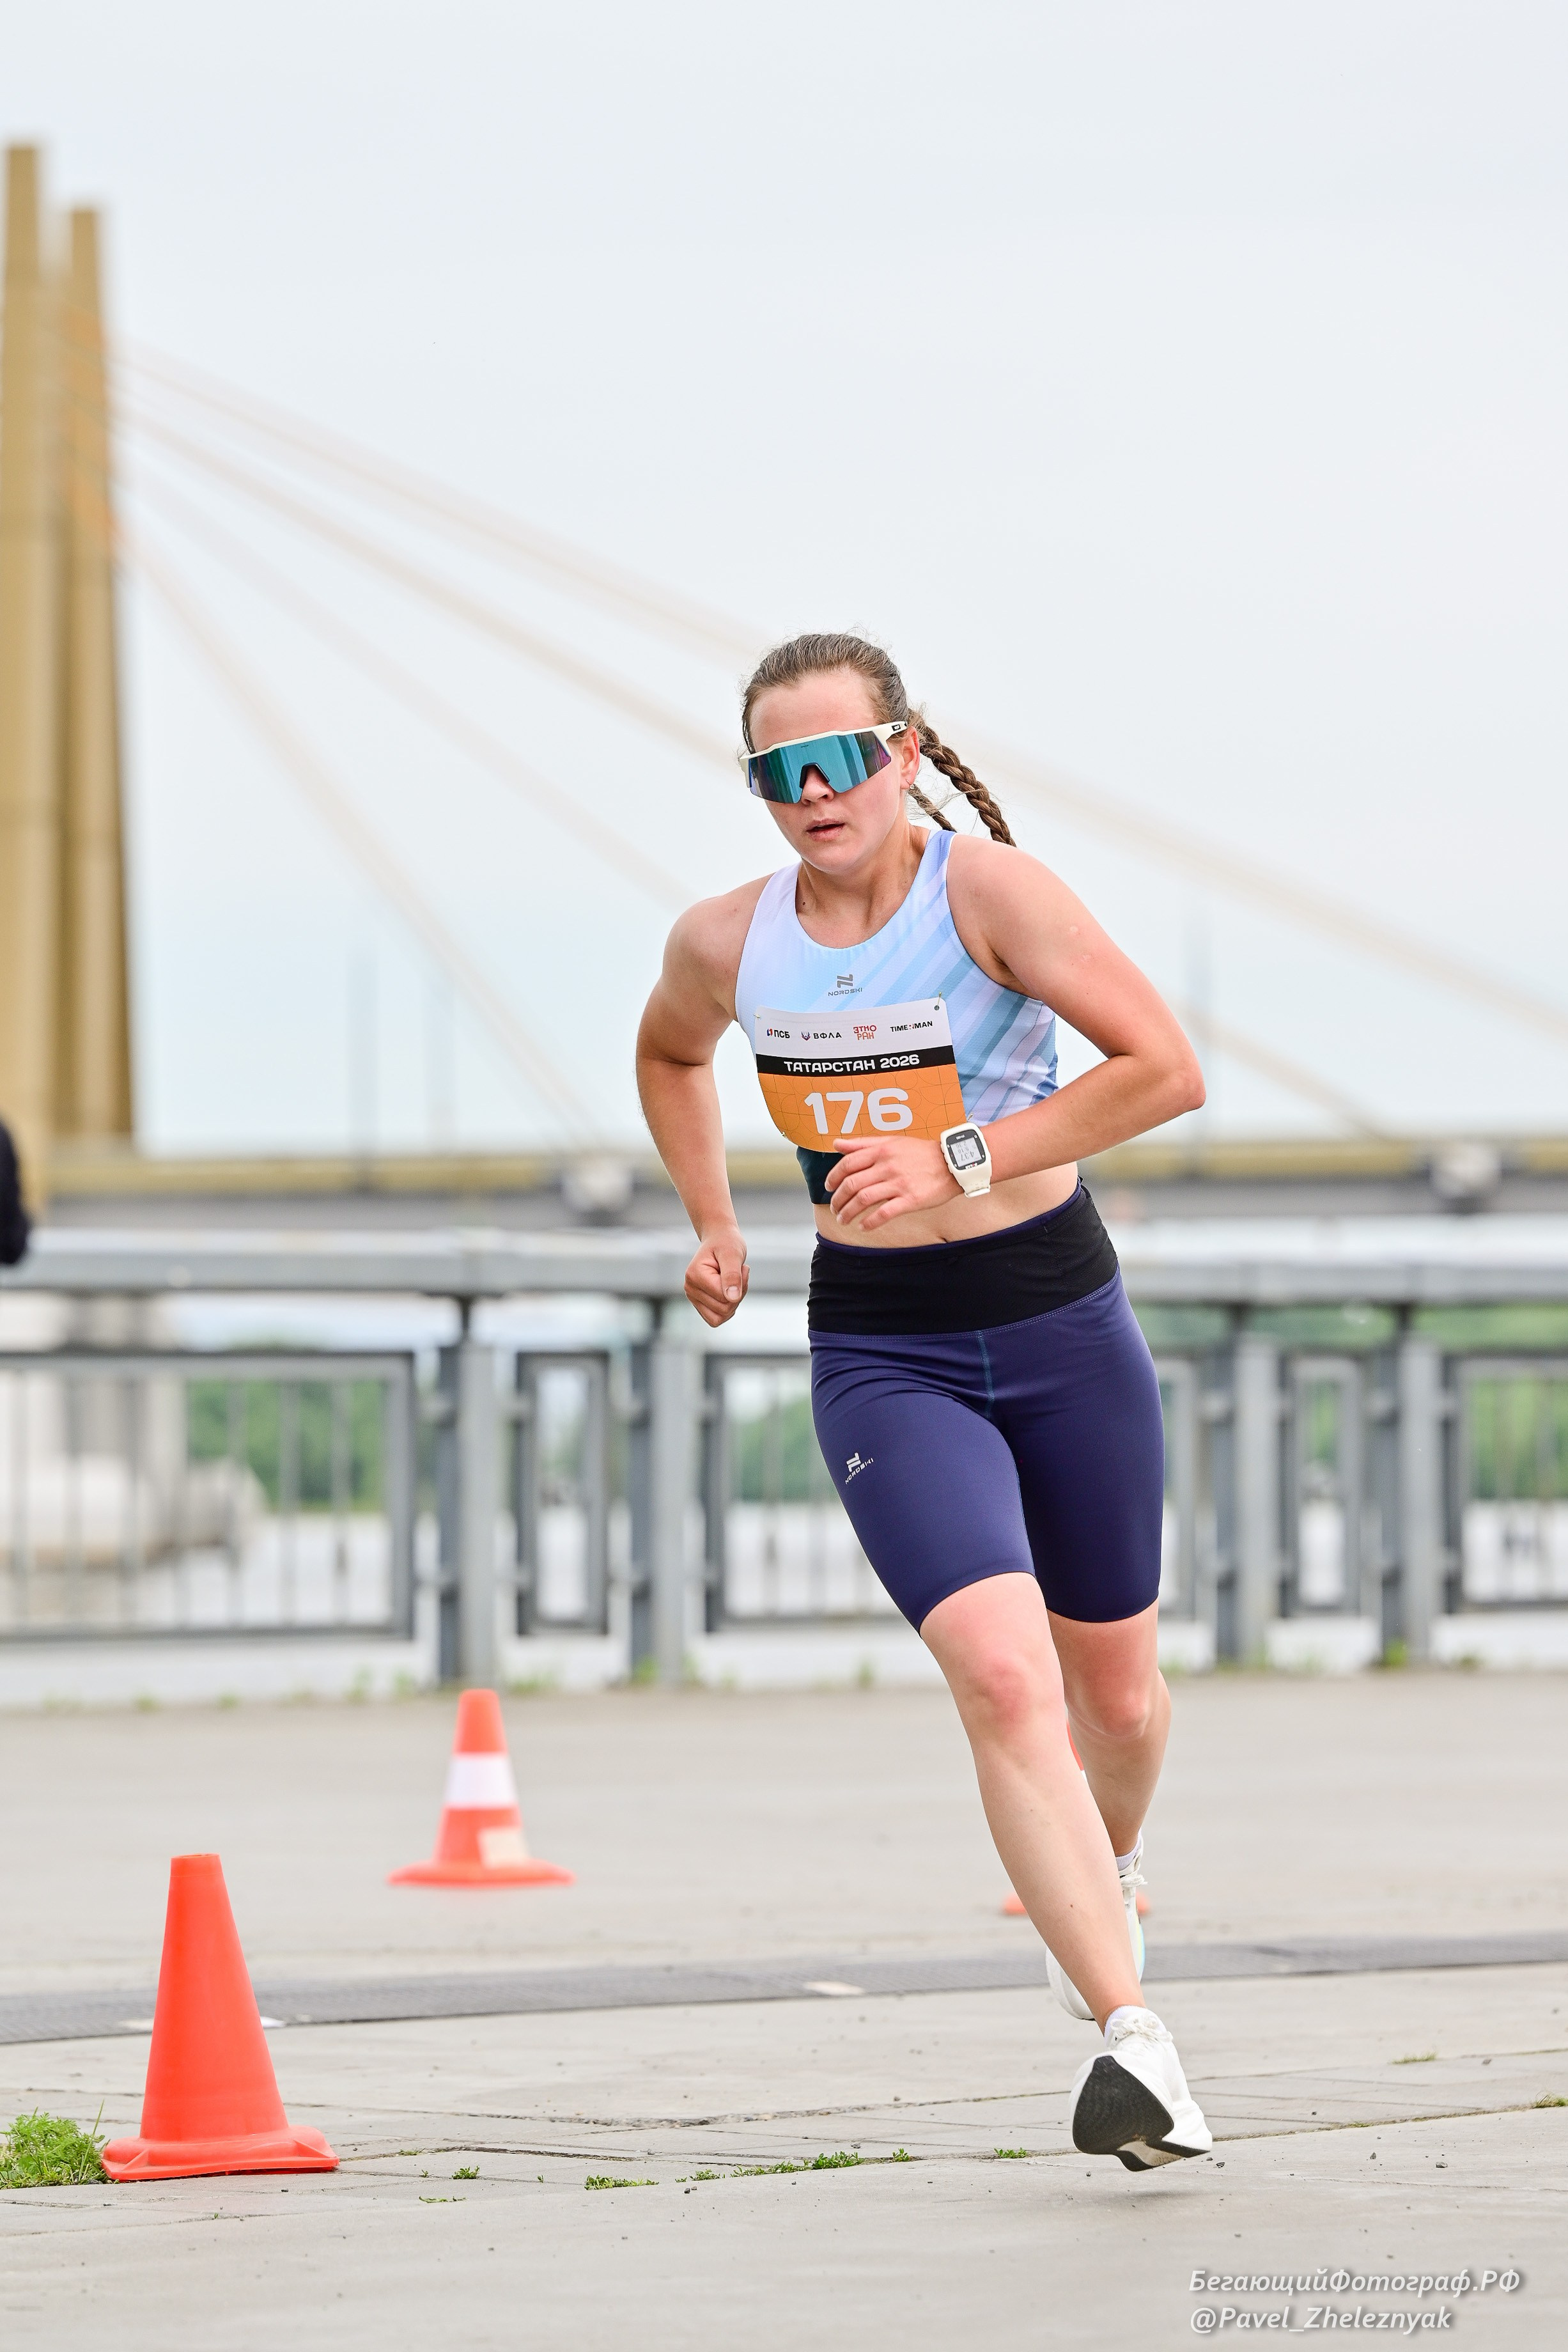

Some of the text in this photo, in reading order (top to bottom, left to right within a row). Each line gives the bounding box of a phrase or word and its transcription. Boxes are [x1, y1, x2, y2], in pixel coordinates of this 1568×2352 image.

[828, 987, 862, 996] NORDSKI
[853, 1025, 876, 1033] ЭТНО
[774, 1030, 790, 1039] ПСБ
[857, 1032, 874, 1040] РАН
[784, 1054, 920, 1073] ТАТАРСТАН 2026
[803, 1087, 913, 1134] 176
